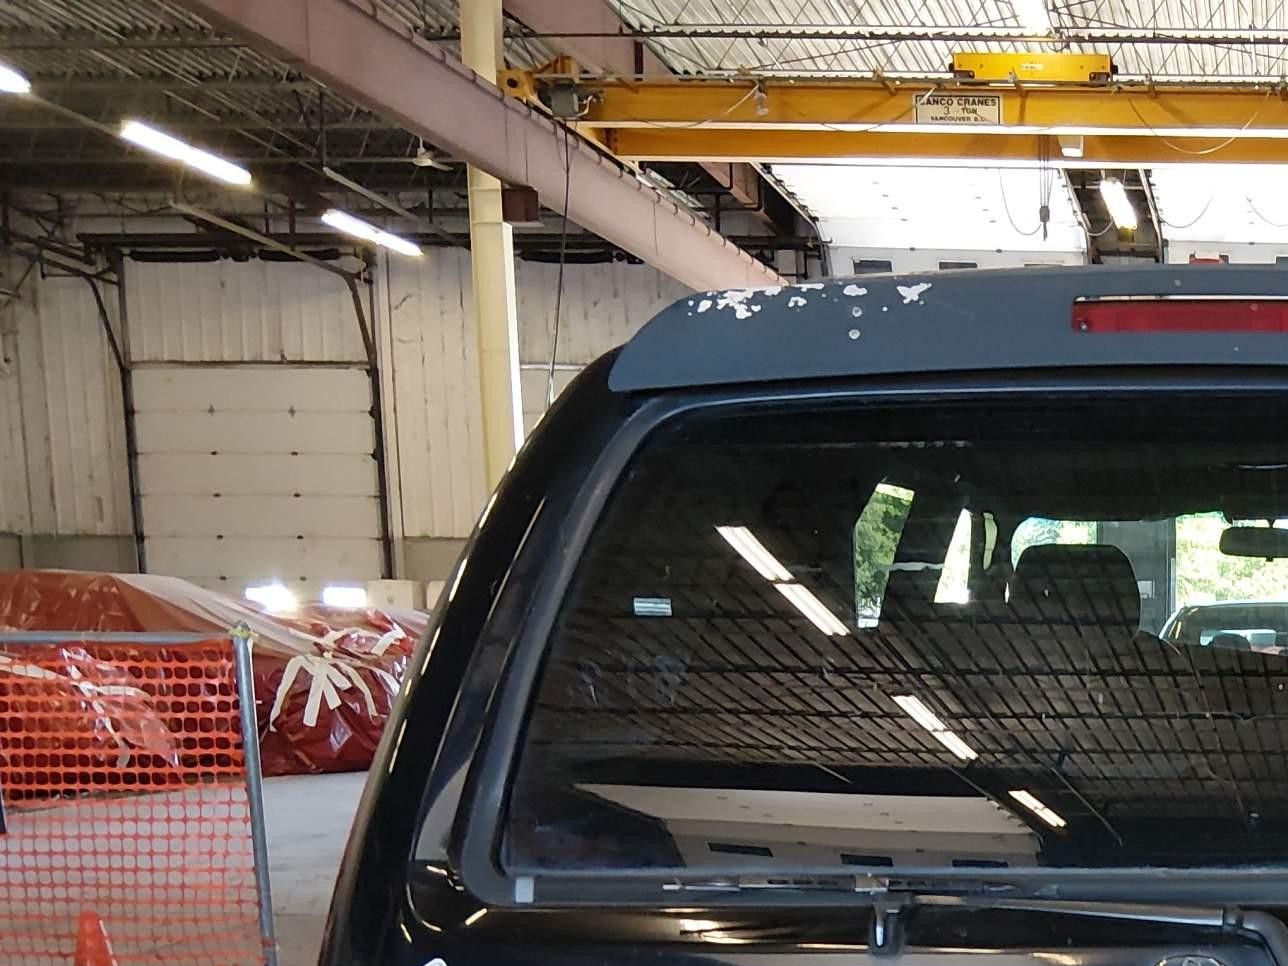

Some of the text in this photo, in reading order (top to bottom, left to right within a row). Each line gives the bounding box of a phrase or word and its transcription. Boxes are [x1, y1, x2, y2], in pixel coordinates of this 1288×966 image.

[957, 98, 997, 107] CRANES
[943, 106, 978, 115] 3 TON
